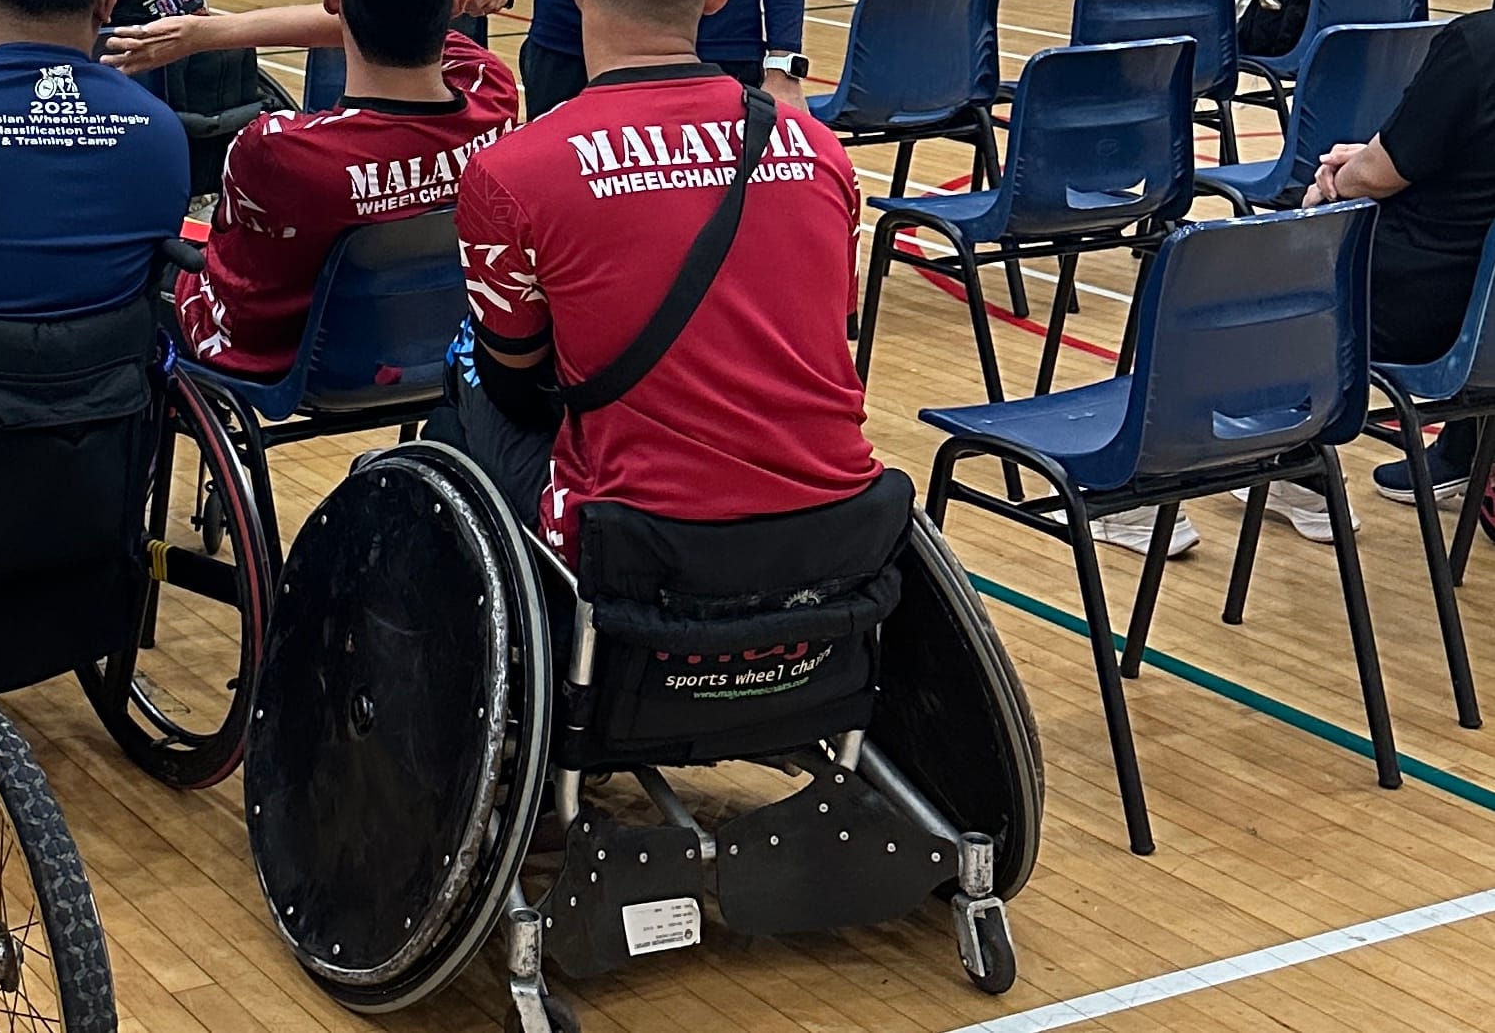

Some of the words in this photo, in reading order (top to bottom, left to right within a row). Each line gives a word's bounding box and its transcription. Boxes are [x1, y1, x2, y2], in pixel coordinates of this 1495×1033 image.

[30, 101, 88, 114] 2025
[28, 114, 107, 125] Wheelchair
[109, 114, 150, 125] Rugby
[87, 125, 126, 135] Clinic
[1, 136, 12, 146] &
[15, 136, 74, 147] Training
[77, 136, 117, 147] Camp
[665, 672, 729, 690] sports
[735, 664, 785, 686] wheel
